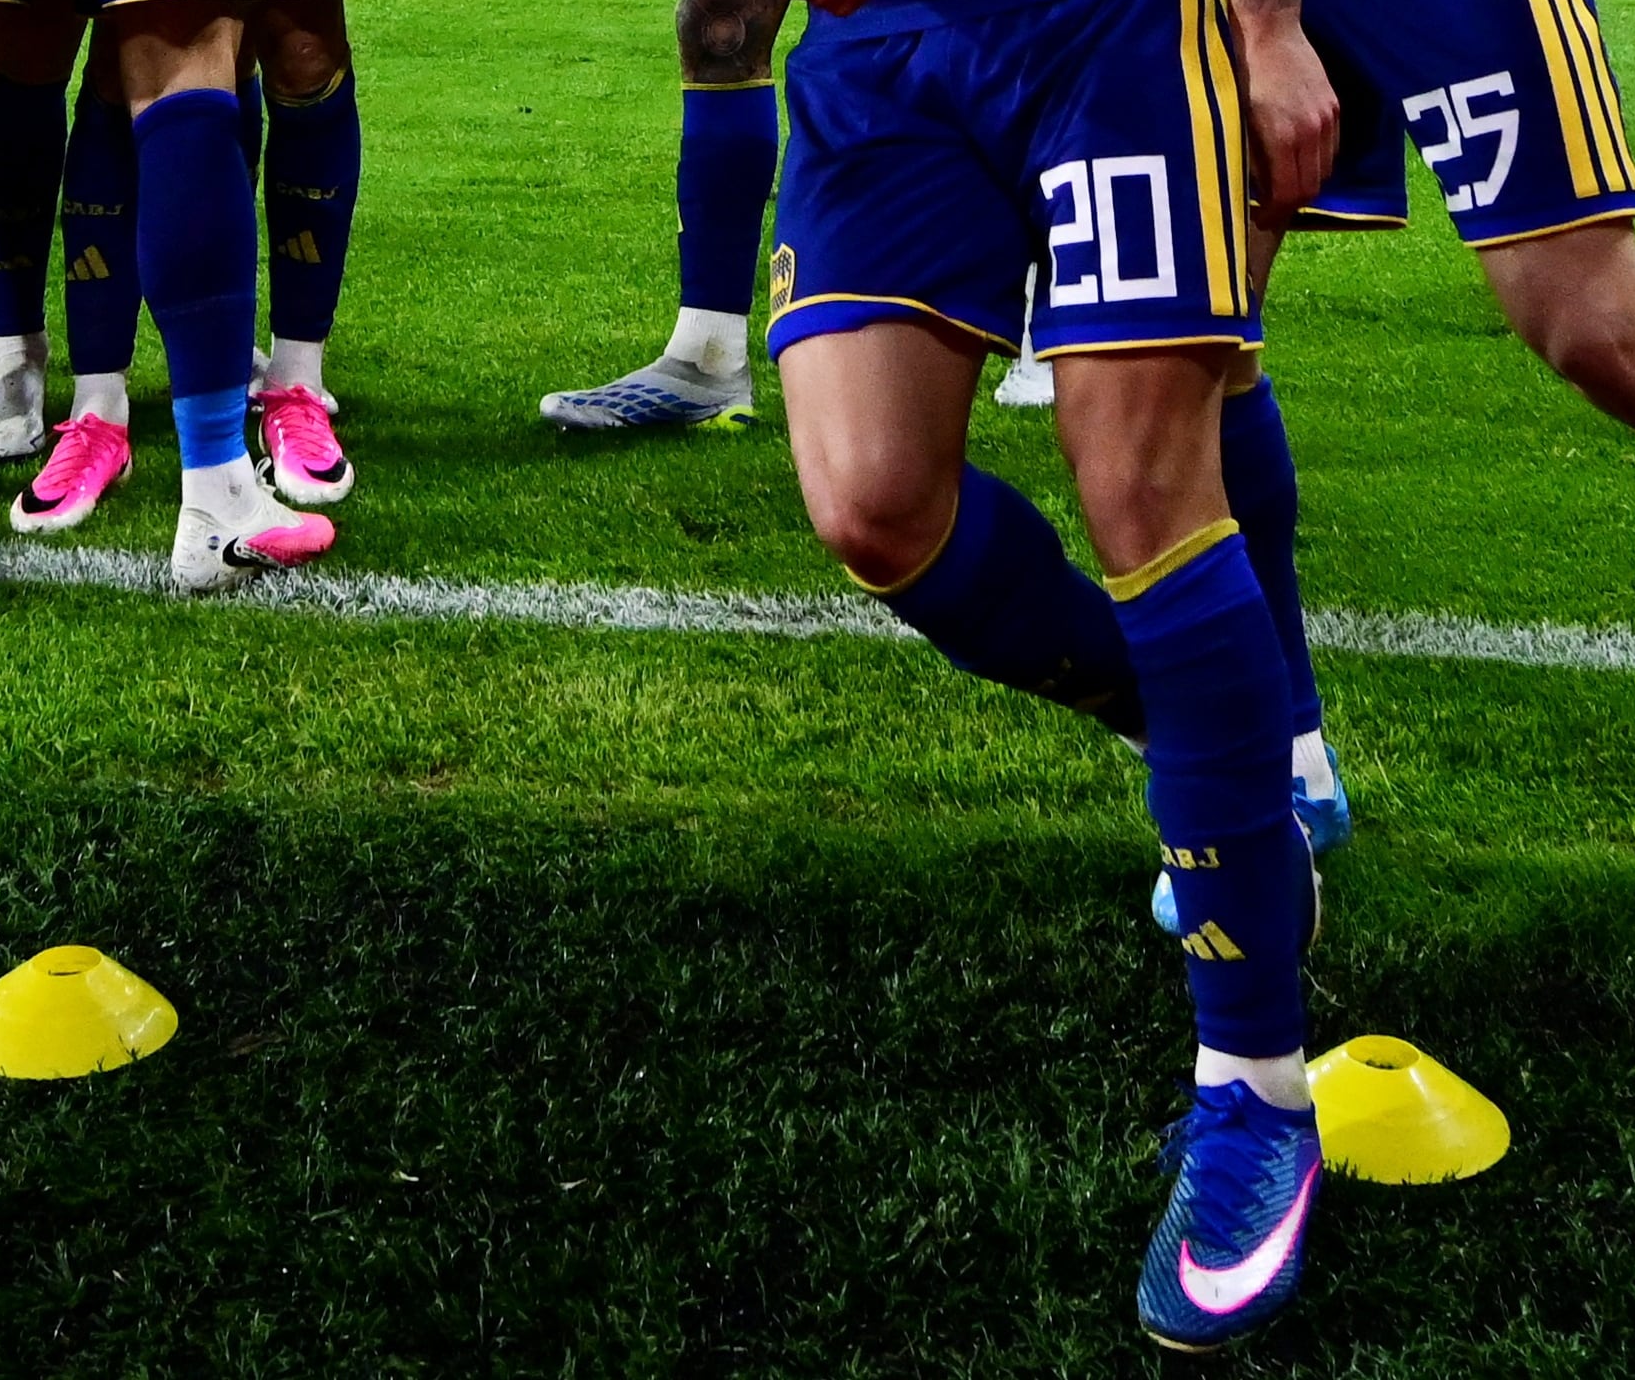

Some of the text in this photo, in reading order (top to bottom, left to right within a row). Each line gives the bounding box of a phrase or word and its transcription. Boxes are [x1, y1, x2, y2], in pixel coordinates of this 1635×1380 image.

[1402, 70, 1520, 212] 25
[1039, 153, 1178, 308] 20
[1160, 841, 1222, 871] ABJ
